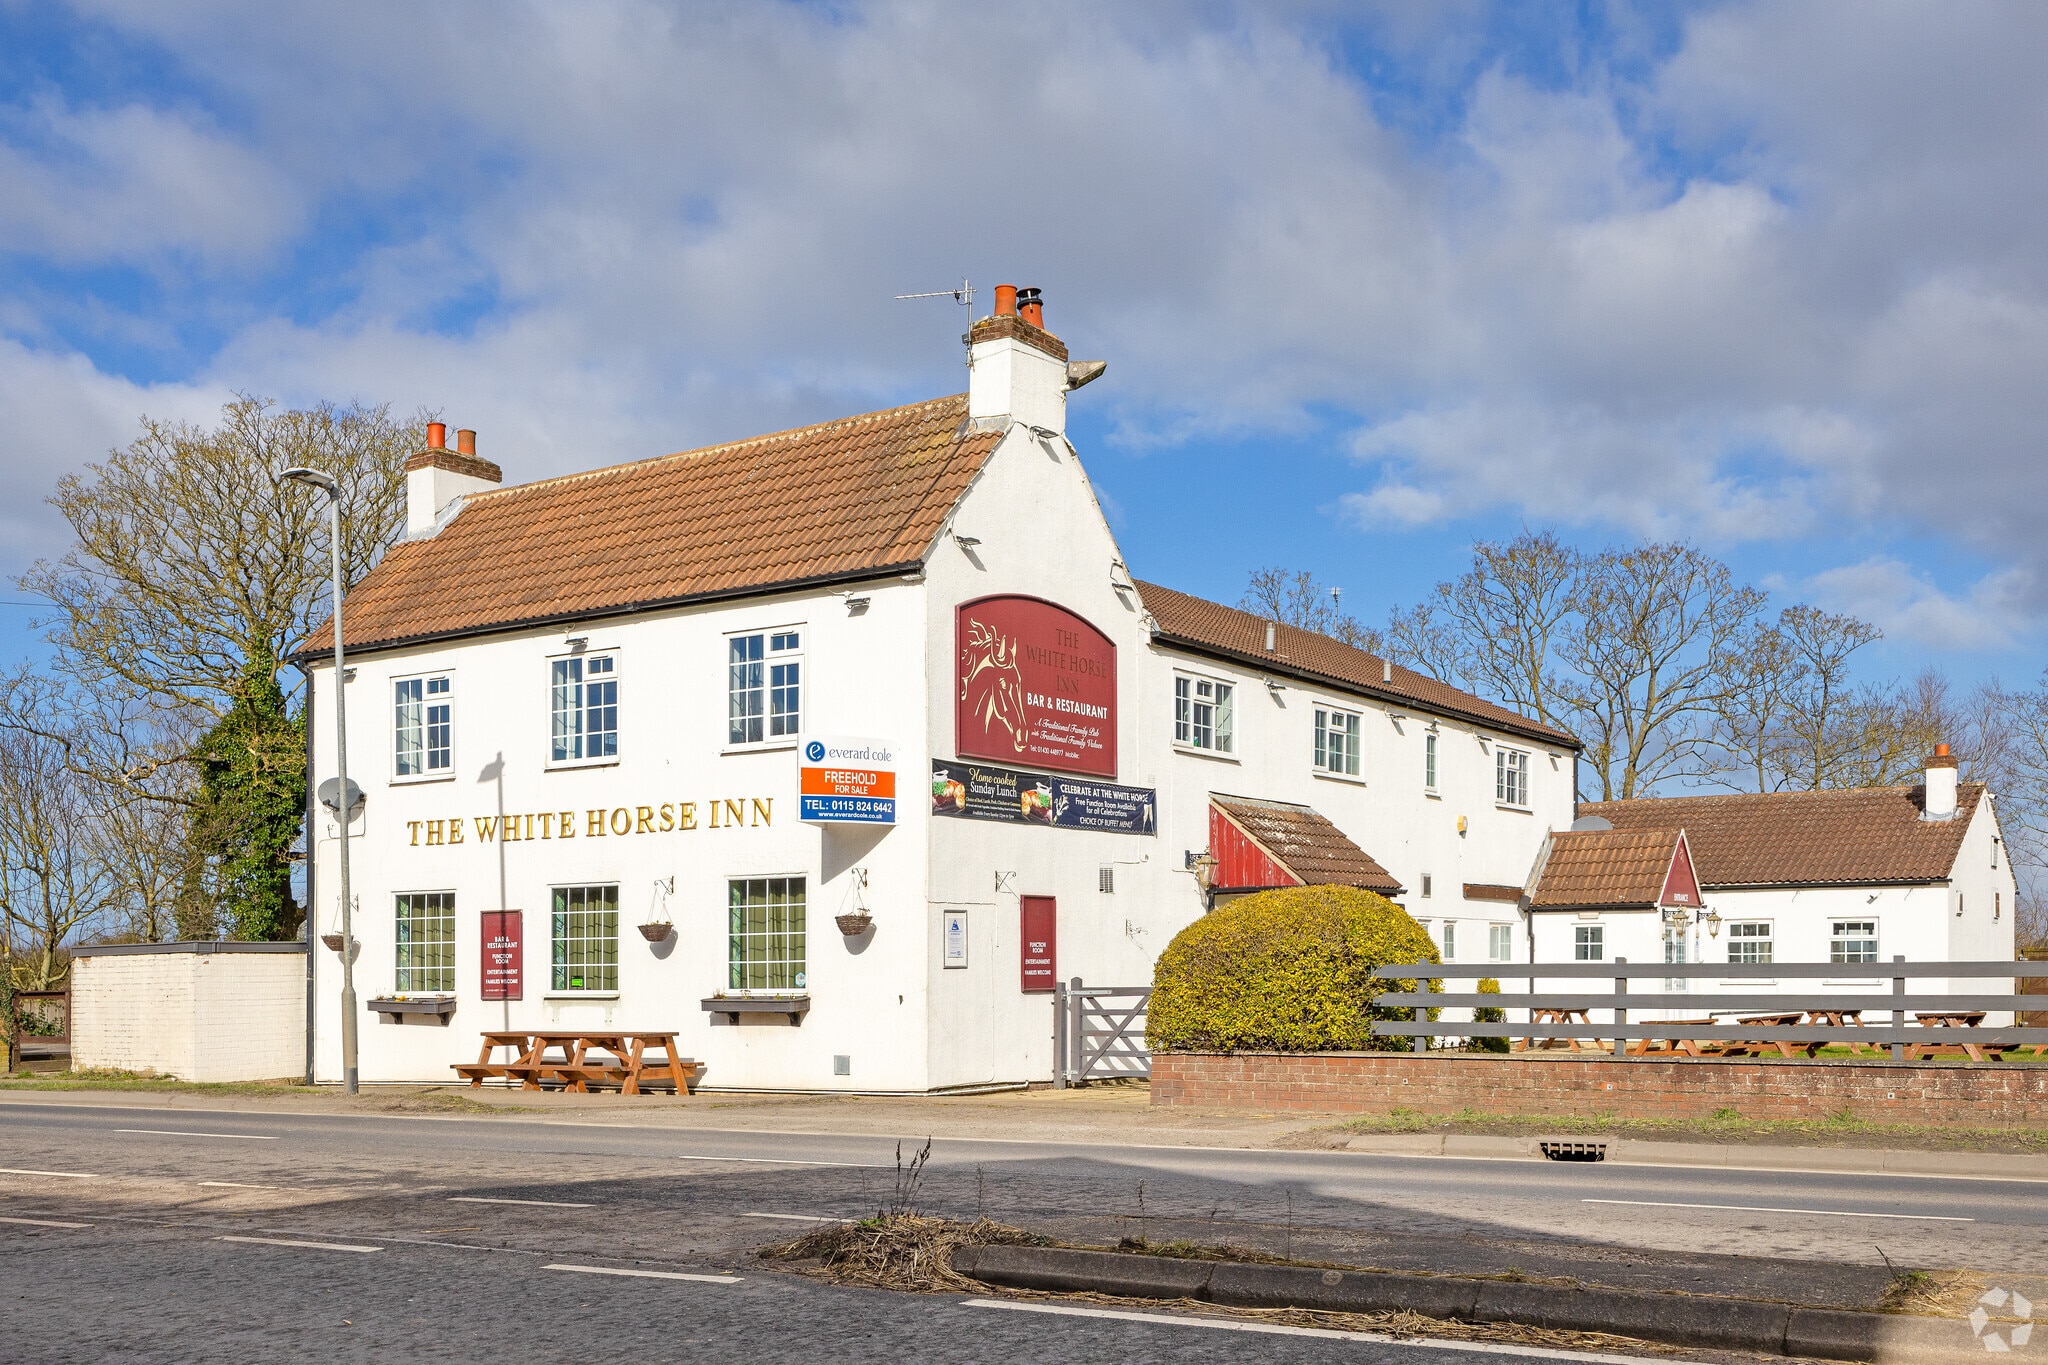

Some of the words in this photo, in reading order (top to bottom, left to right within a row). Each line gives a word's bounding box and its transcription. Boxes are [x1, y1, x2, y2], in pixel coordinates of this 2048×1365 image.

[1056, 628, 1079, 649] THE
[1026, 644, 1066, 670] WHITE
[1069, 655, 1107, 679] HORSE
[1056, 675, 1079, 694] INN
[1027, 692, 1045, 708] BAR
[1047, 697, 1053, 709] &
[1056, 697, 1108, 720] RESTAURANT
[1042, 718, 1071, 732] Traditional
[1070, 724, 1088, 738] Family
[1040, 730, 1069, 744] Traditional
[1068, 735, 1086, 749] Family
[828, 746, 870, 760] everard
[872, 747, 892, 761] cole
[824, 771, 877, 785] FREEHOLD
[969, 768, 993, 783] Home
[993, 772, 1017, 786] cooked
[835, 785, 850, 794] FOR
[851, 786, 868, 795] SALE
[970, 781, 995, 798] Sunday
[996, 784, 1018, 798] Lunch
[1060, 784, 1092, 796] CELEBRATE
[1092, 789, 1100, 797] AT
[1101, 789, 1112, 798] THE
[1112, 791, 1130, 801] WHITE
[1131, 793, 1148, 802] HORSE
[805, 799, 829, 810] TEL:
[831, 800, 854, 811] 0115
[856, 801, 871, 812] 824
[873, 802, 892, 813] 6442
[1075, 797, 1086, 806] Free
[1086, 799, 1104, 808] Function
[1104, 801, 1117, 809] Room
[1117, 802, 1136, 811] Available
[1100, 808, 1128, 817] Celebrations
[407, 818, 465, 847] THE
[473, 811, 576, 844] WHITE
[586, 801, 698, 838] HORSE
[708, 797, 774, 829] INN
[818, 811, 883, 819] www.everardcole.co.uk
[1080, 817, 1097, 825] CHOICE
[1097, 818, 1104, 826] OF
[1105, 819, 1119, 827] BUFFET
